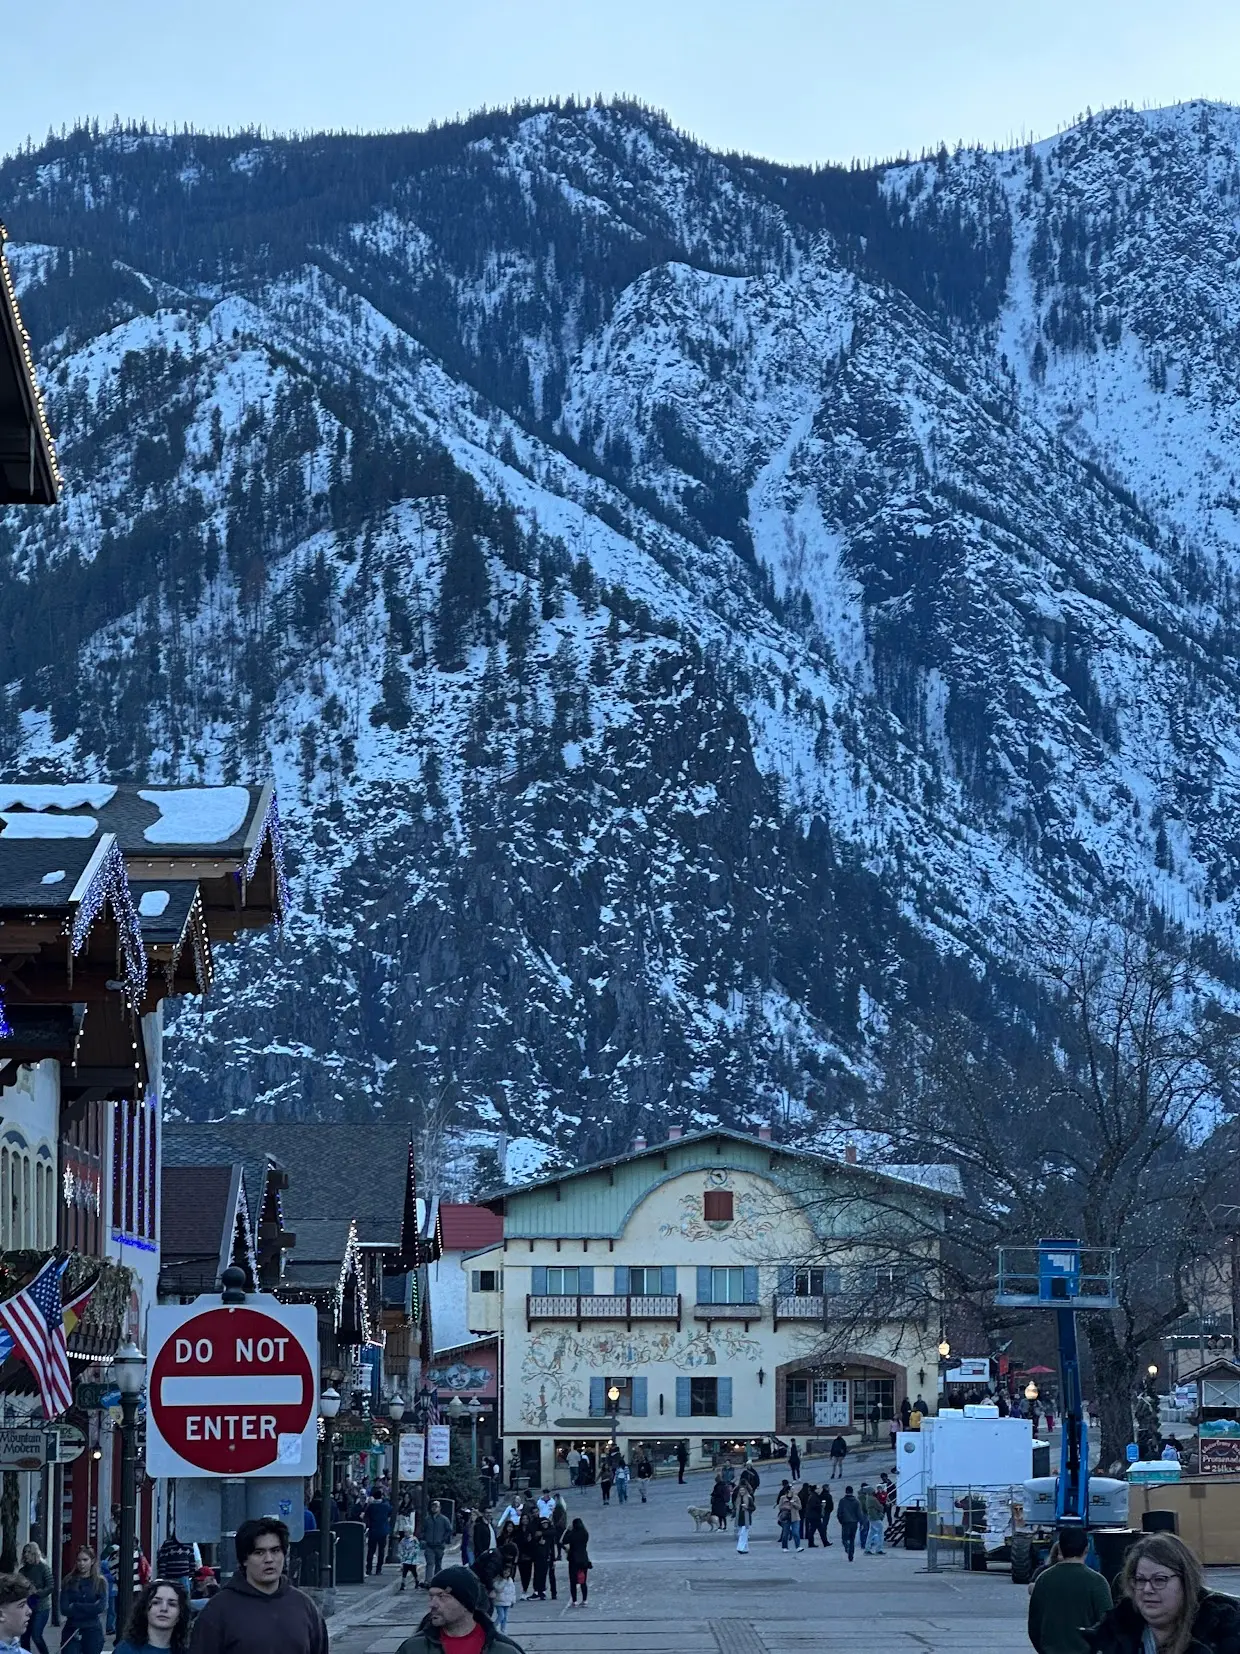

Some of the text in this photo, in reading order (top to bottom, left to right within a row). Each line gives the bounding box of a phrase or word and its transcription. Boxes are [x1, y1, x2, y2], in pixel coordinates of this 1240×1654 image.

[175, 1337, 290, 1363] DO NOT
[0, 1432, 41, 1442] Mountain
[185, 1415, 277, 1441] ENTER
[3, 1443, 40, 1454] Modern
